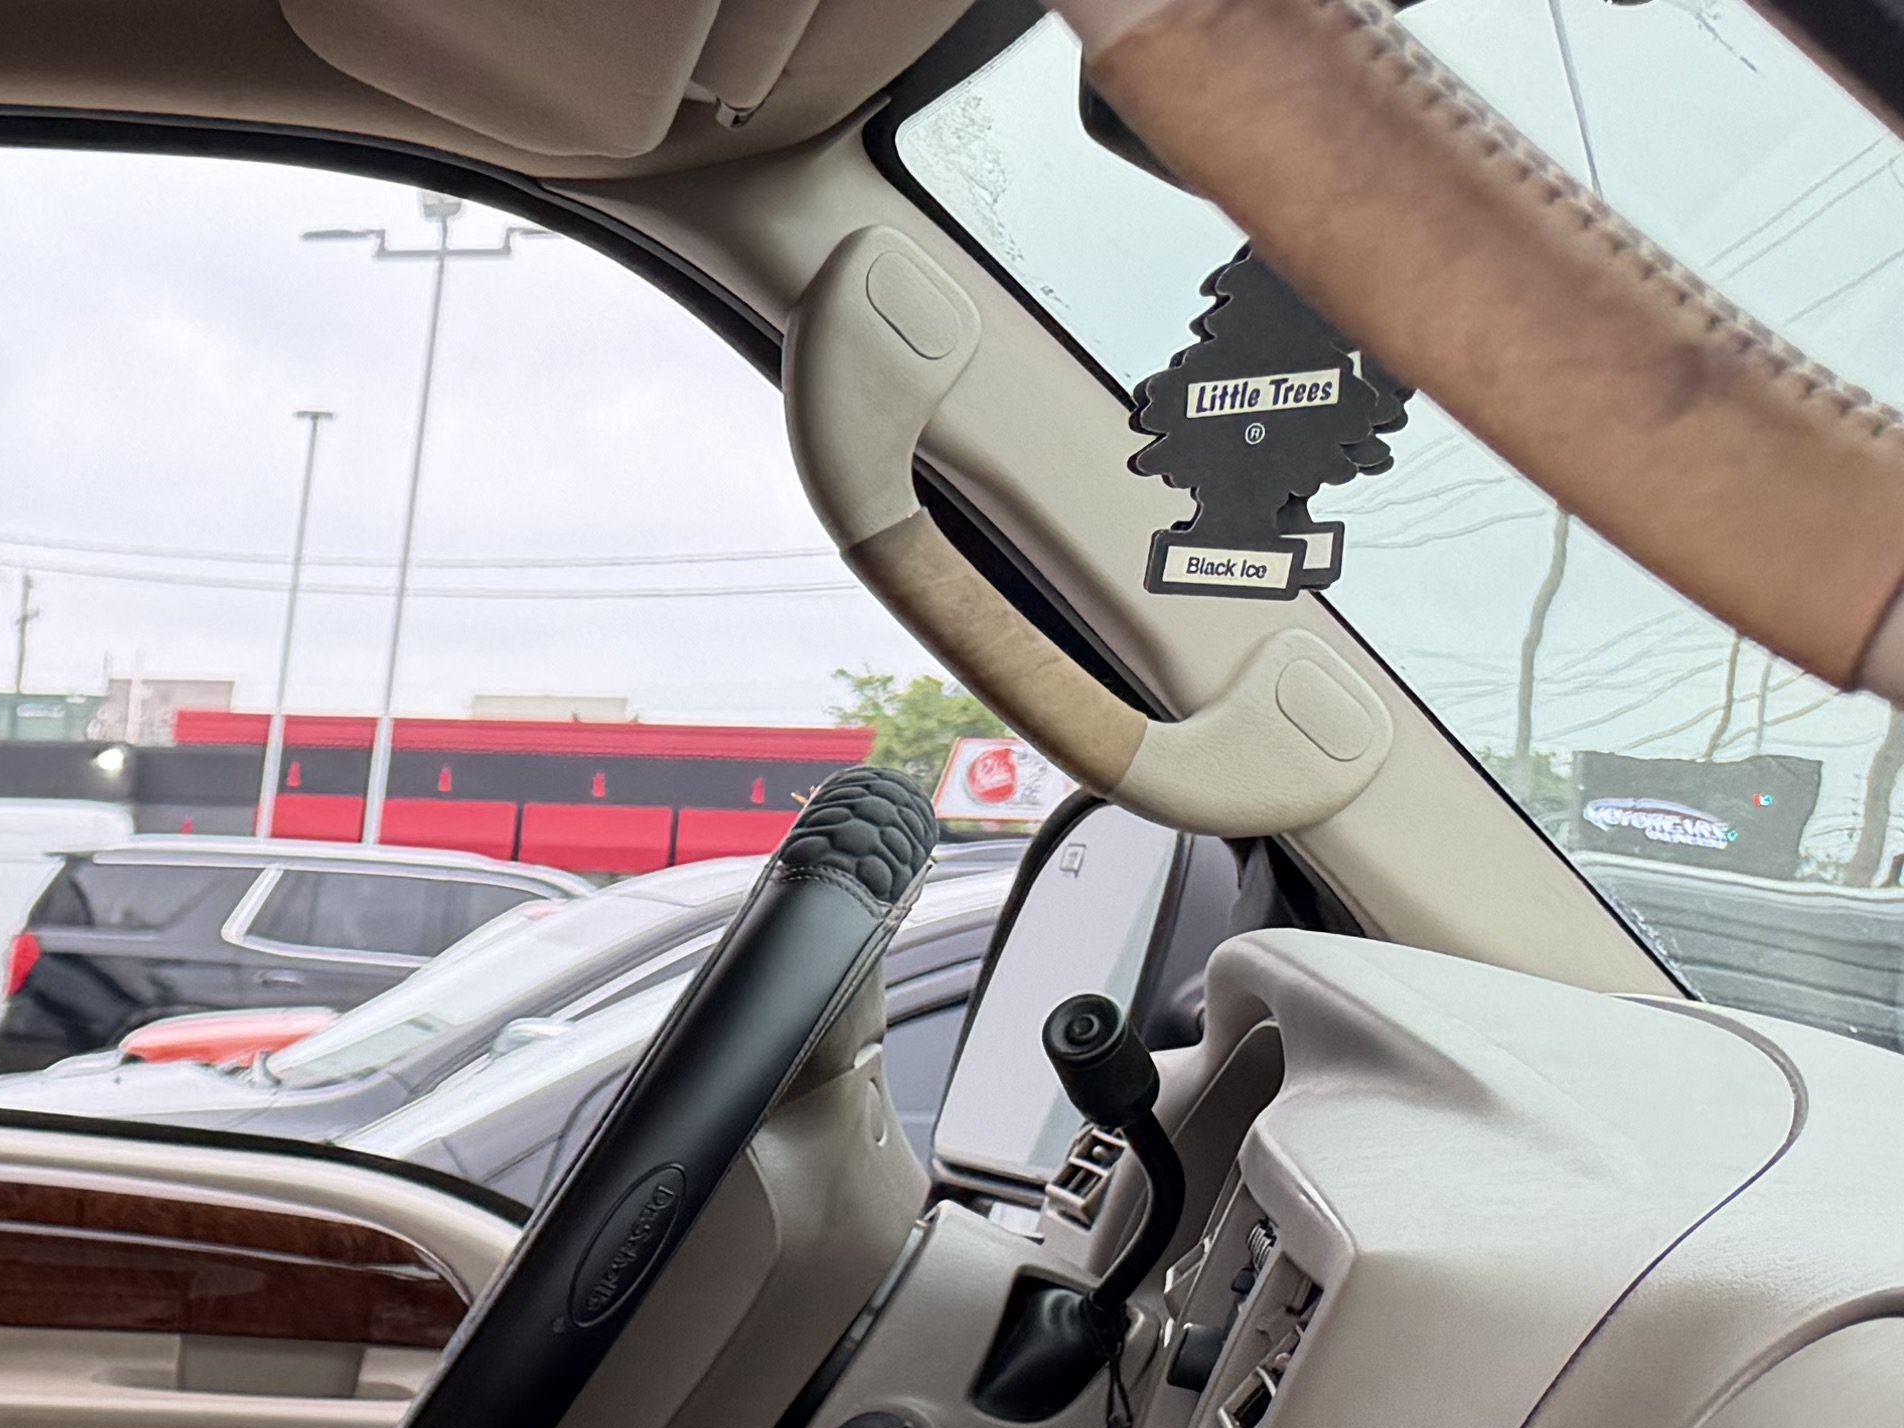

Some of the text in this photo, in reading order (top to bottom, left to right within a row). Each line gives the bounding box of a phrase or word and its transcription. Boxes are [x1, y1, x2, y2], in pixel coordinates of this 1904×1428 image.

[1195, 377, 1334, 416] Little Trees
[1185, 557, 1268, 581] Black Ice
